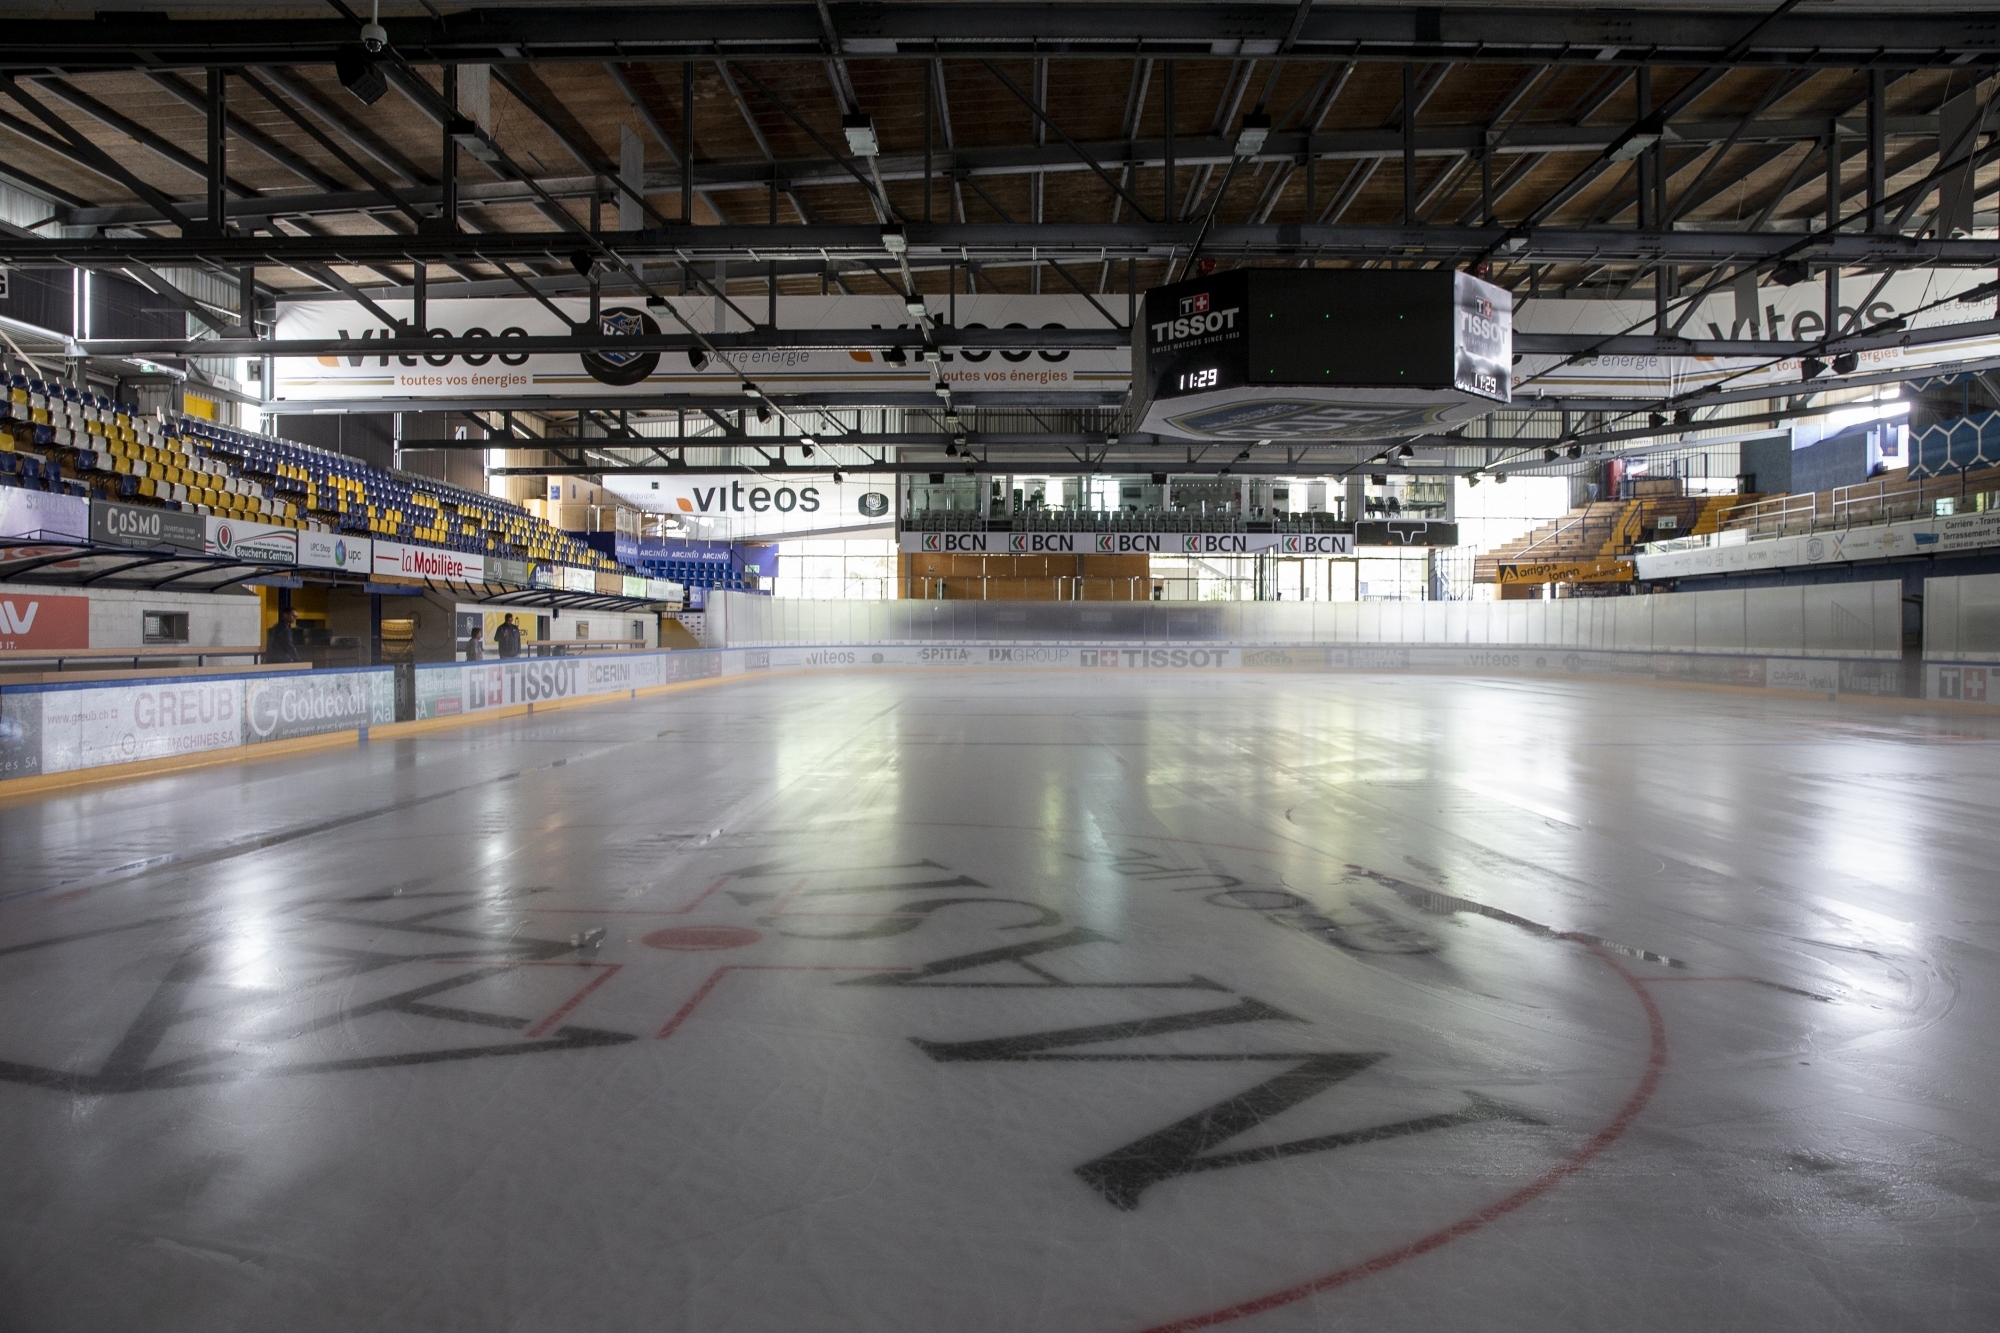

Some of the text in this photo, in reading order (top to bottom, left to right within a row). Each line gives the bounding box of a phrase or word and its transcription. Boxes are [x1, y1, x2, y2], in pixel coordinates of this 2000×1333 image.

[1152, 307, 1240, 342] TISSOT
[1461, 311, 1508, 344] TISSOT
[1152, 331, 1240, 354] SWISS WATCHES SINCE 1853
[400, 372, 527, 388] toutes vos énergies
[983, 371, 1007, 382] vos
[1009, 369, 1068, 384] énergies
[1180, 368, 1218, 390] 11:29
[1474, 373, 1497, 394] 11:29
[692, 480, 821, 513] viteos
[1945, 519, 1974, 530] Carrière
[944, 533, 987, 551] BCN
[1031, 533, 1074, 552] BCN
[1118, 533, 1161, 552] BCN
[1204, 533, 1247, 552] BCN
[1304, 534, 1346, 552] BCN
[1942, 528, 1990, 541] Terrassement
[236, 546, 293, 562] Boucherie Centrale
[310, 542, 331, 554] UPC Shop
[348, 550, 361, 565] upc
[401, 548, 412, 572] la
[414, 550, 463, 578] Mobilière
[1519, 565, 1550, 578] arrigo
[1548, 567, 1580, 581] tonon
[810, 650, 855, 665] viteos
[1122, 650, 1230, 668] TISSOT
[1470, 651, 1520, 668] viteos
[505, 660, 580, 703] TISSOT
[595, 663, 631, 684] CERINI
[134, 686, 234, 731] GREUB
[281, 684, 367, 723] Goldec.ch
[47, 709, 110, 726] www.greub.ch
[167, 731, 235, 751] MACHINES SA
[25, 756, 38, 769] SA
